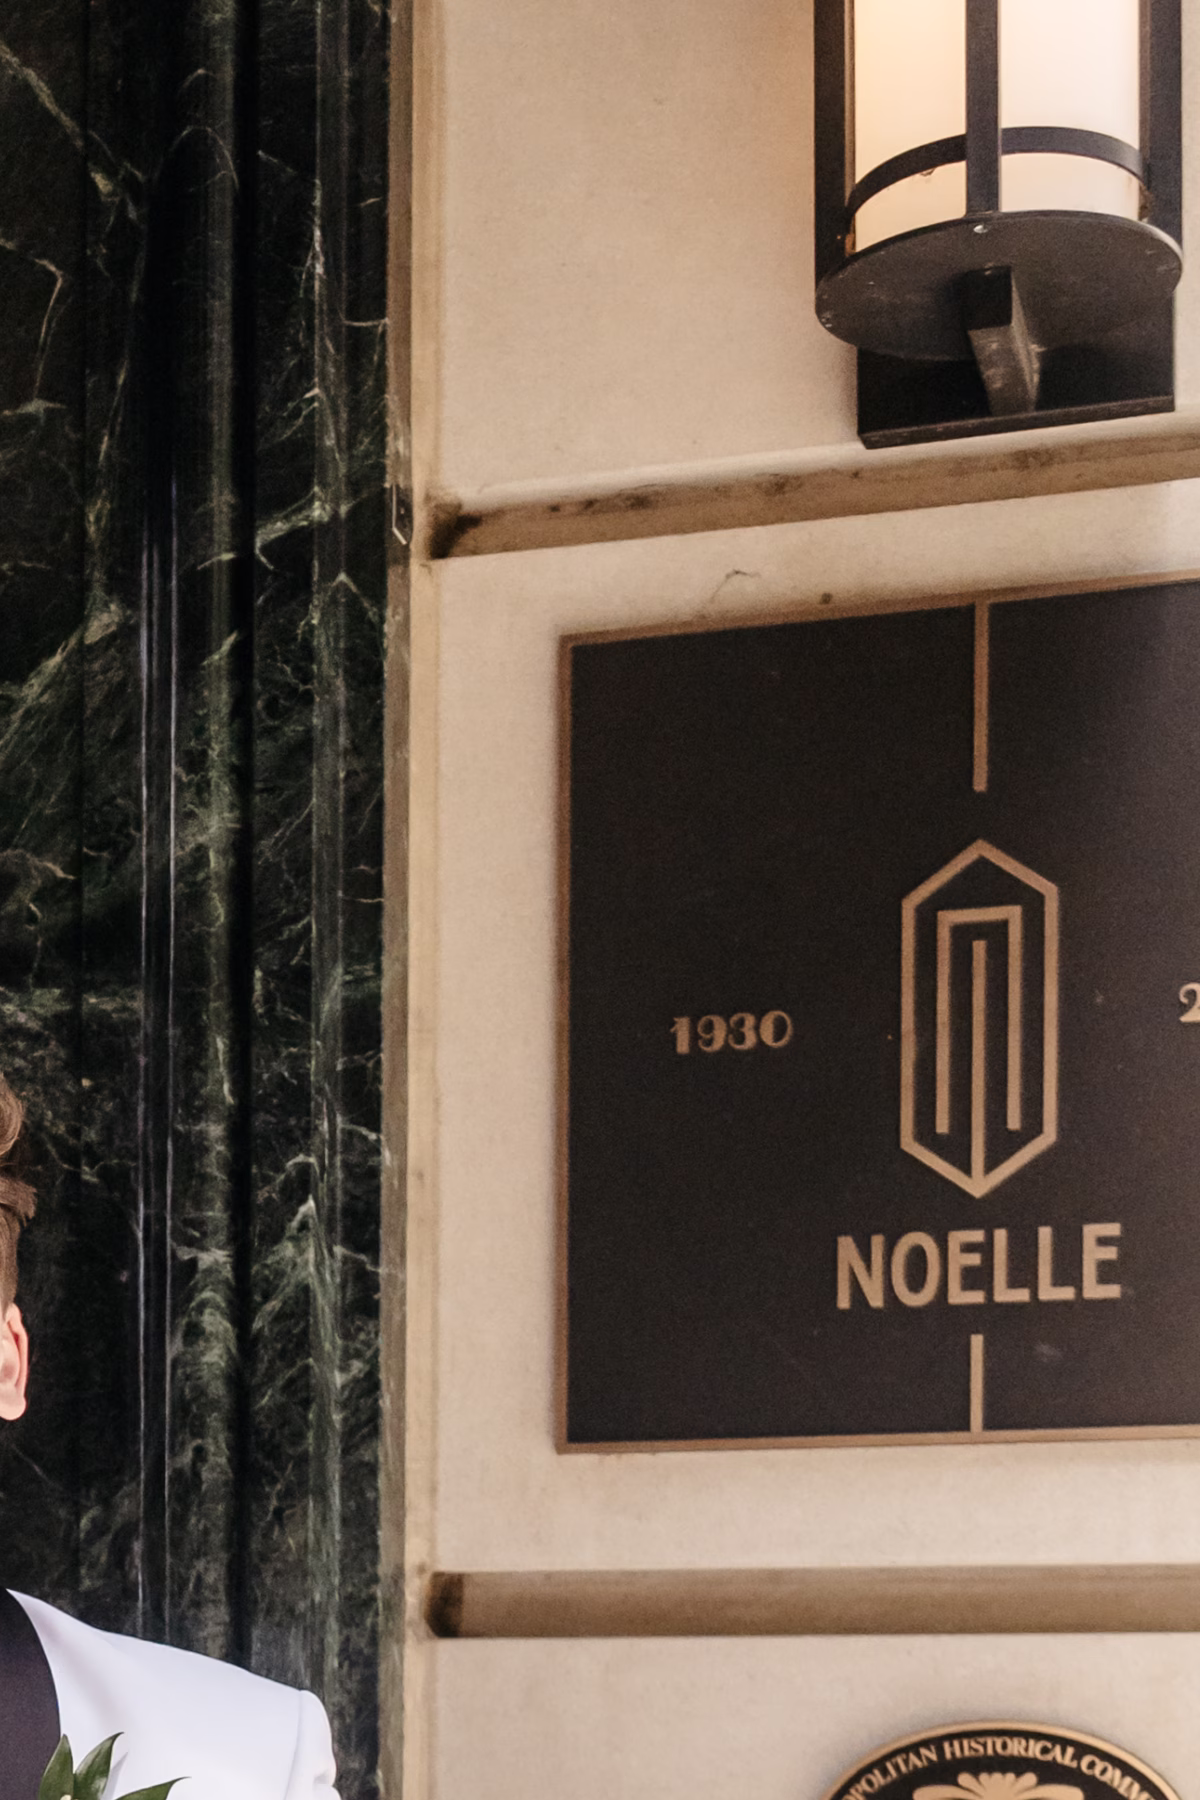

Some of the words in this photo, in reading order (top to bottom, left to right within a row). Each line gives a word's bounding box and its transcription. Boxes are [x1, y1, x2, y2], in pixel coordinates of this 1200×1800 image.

[669, 1009, 794, 1055] 1930
[836, 1222, 1122, 1310] NOELLE
[943, 1735, 1078, 1769] HISTORICAL
